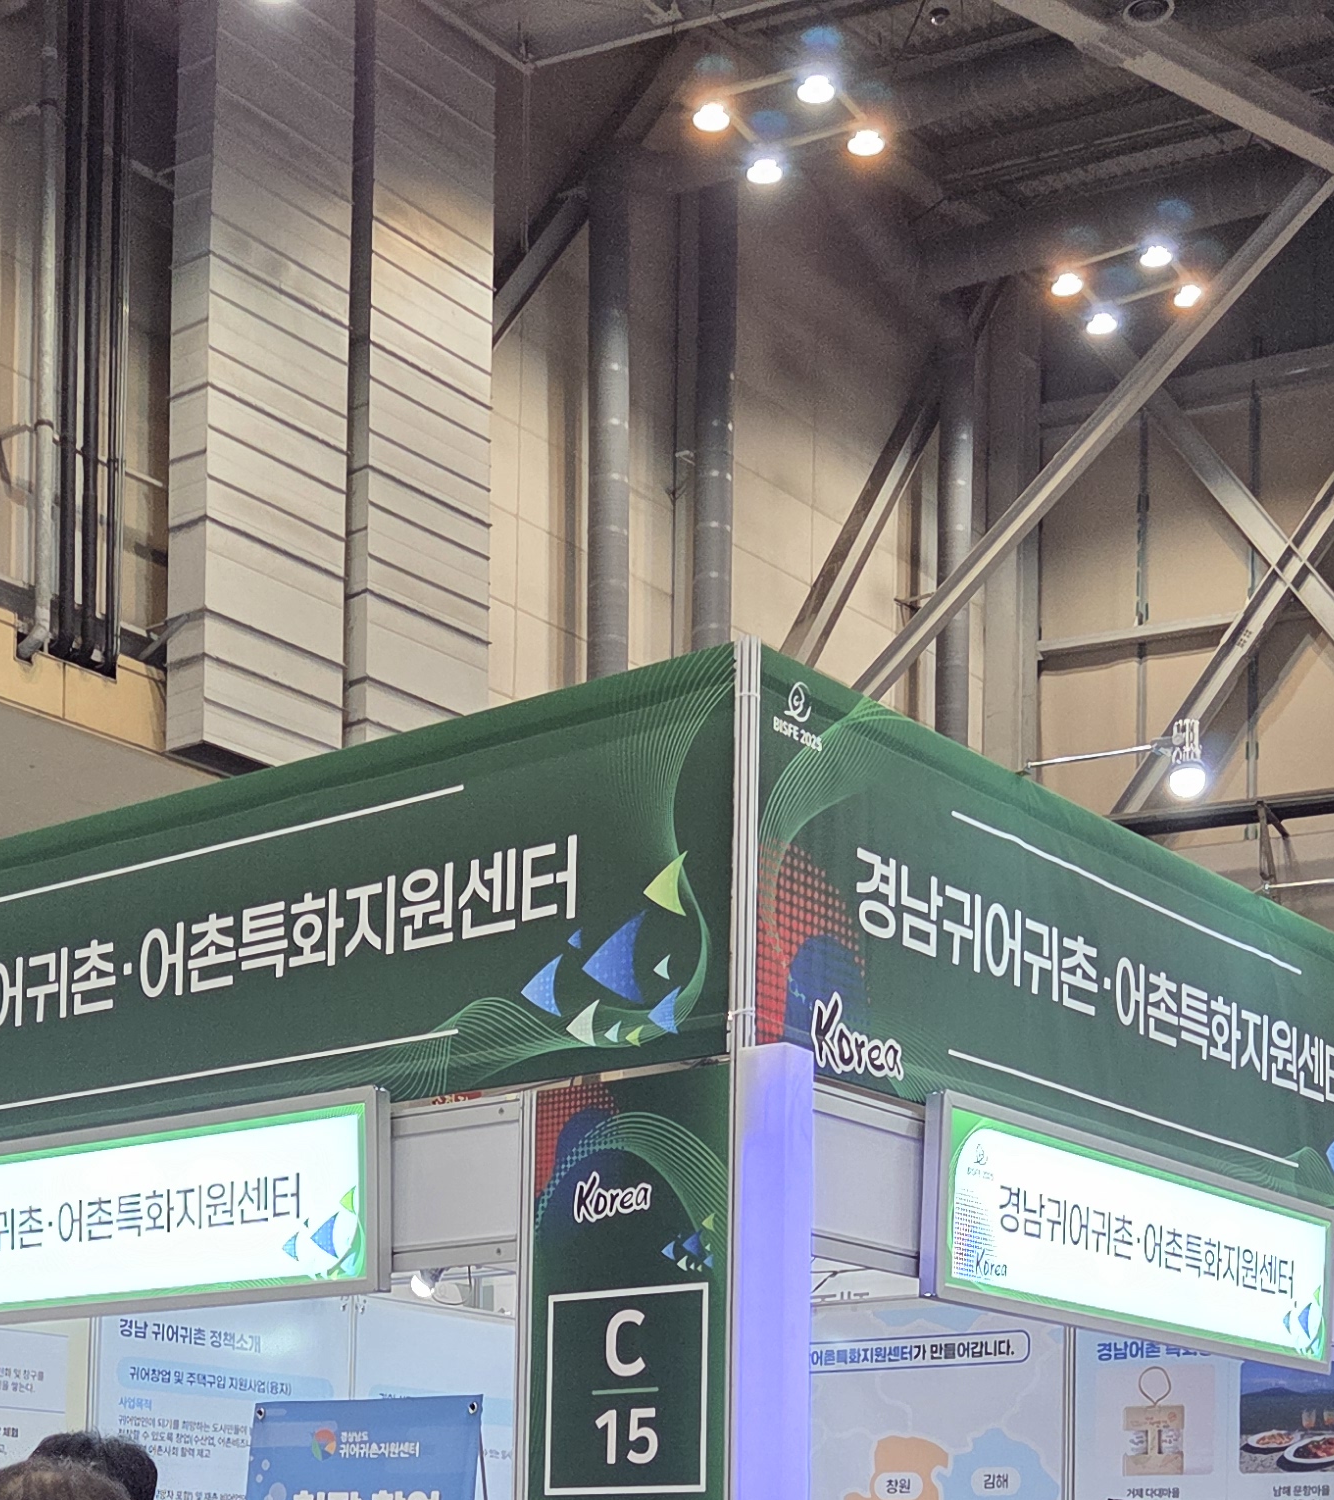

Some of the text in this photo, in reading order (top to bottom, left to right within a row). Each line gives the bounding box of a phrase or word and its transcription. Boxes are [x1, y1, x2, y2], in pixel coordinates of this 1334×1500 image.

[773, 716, 799, 741] BISFE
[811, 992, 904, 1082] Korea
[573, 1172, 652, 1223] Korea
[1000, 1184, 1295, 1299] 경남귀어귀촌·어촌특화지원센터
[976, 1248, 1007, 1277] Korea
[120, 1319, 261, 1353] 경남 귀어귀촌 정책소개
[605, 1309, 646, 1377] C
[1097, 1340, 1161, 1361] 경남어촌
[810, 1339, 1015, 1366] 어촌특화지원센터가 만들어갑니다.
[129, 1366, 171, 1383] 귀어창업
[174, 1371, 183, 1385] 및
[594, 1406, 659, 1465] 15
[886, 1479, 911, 1494] 창원
[984, 1474, 1008, 1490] 김해
